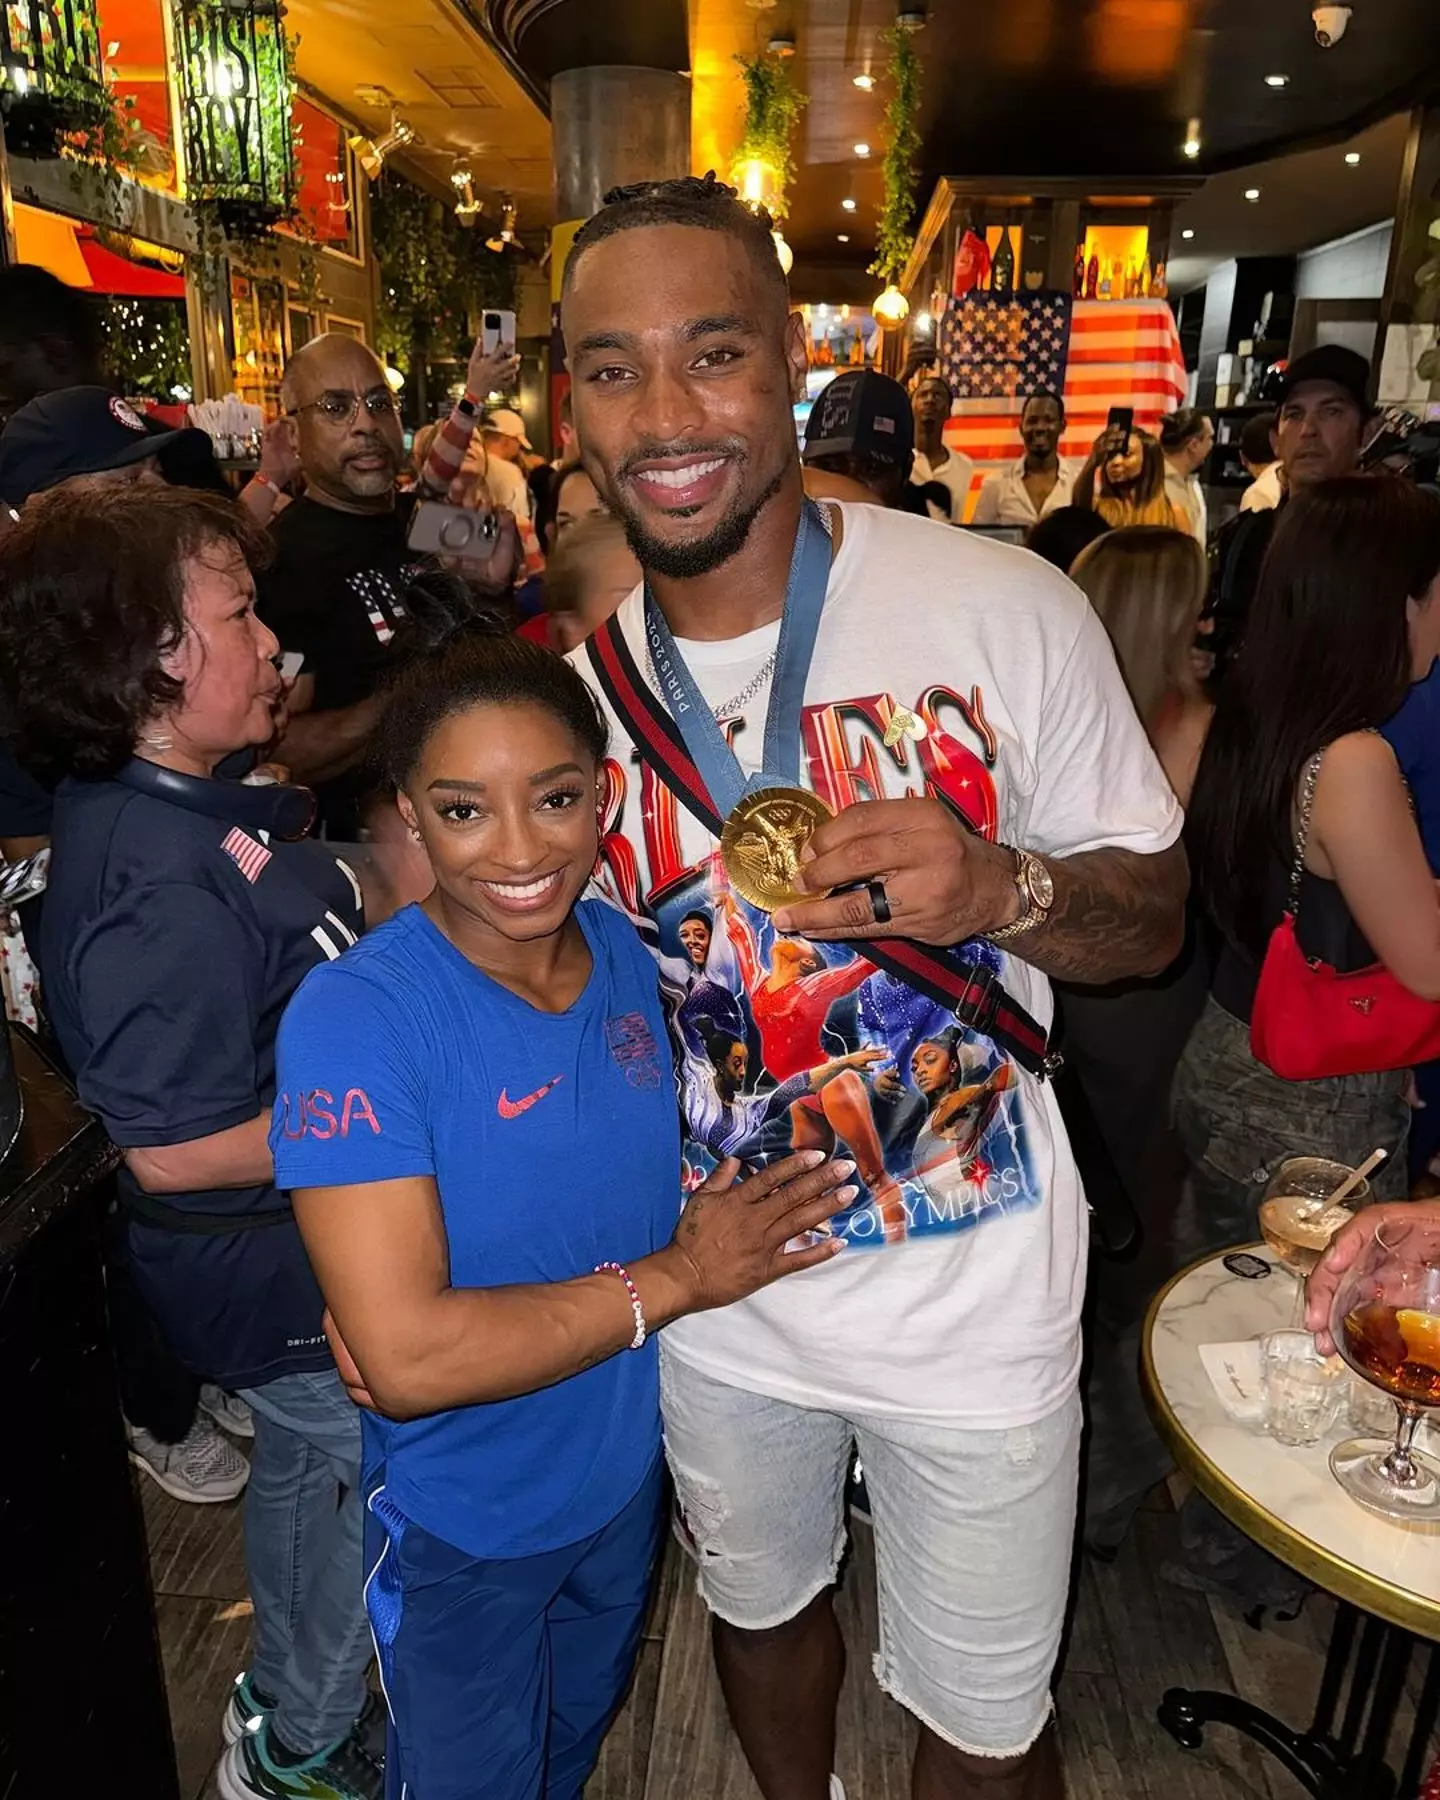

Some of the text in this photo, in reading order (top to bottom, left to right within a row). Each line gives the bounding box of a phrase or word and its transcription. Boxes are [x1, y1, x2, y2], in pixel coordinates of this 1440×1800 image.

[661, 660, 690, 713] PARIS
[600, 683, 997, 916] IES
[283, 1088, 381, 1140] USA
[849, 1166, 1020, 1237] OLYMPICS
